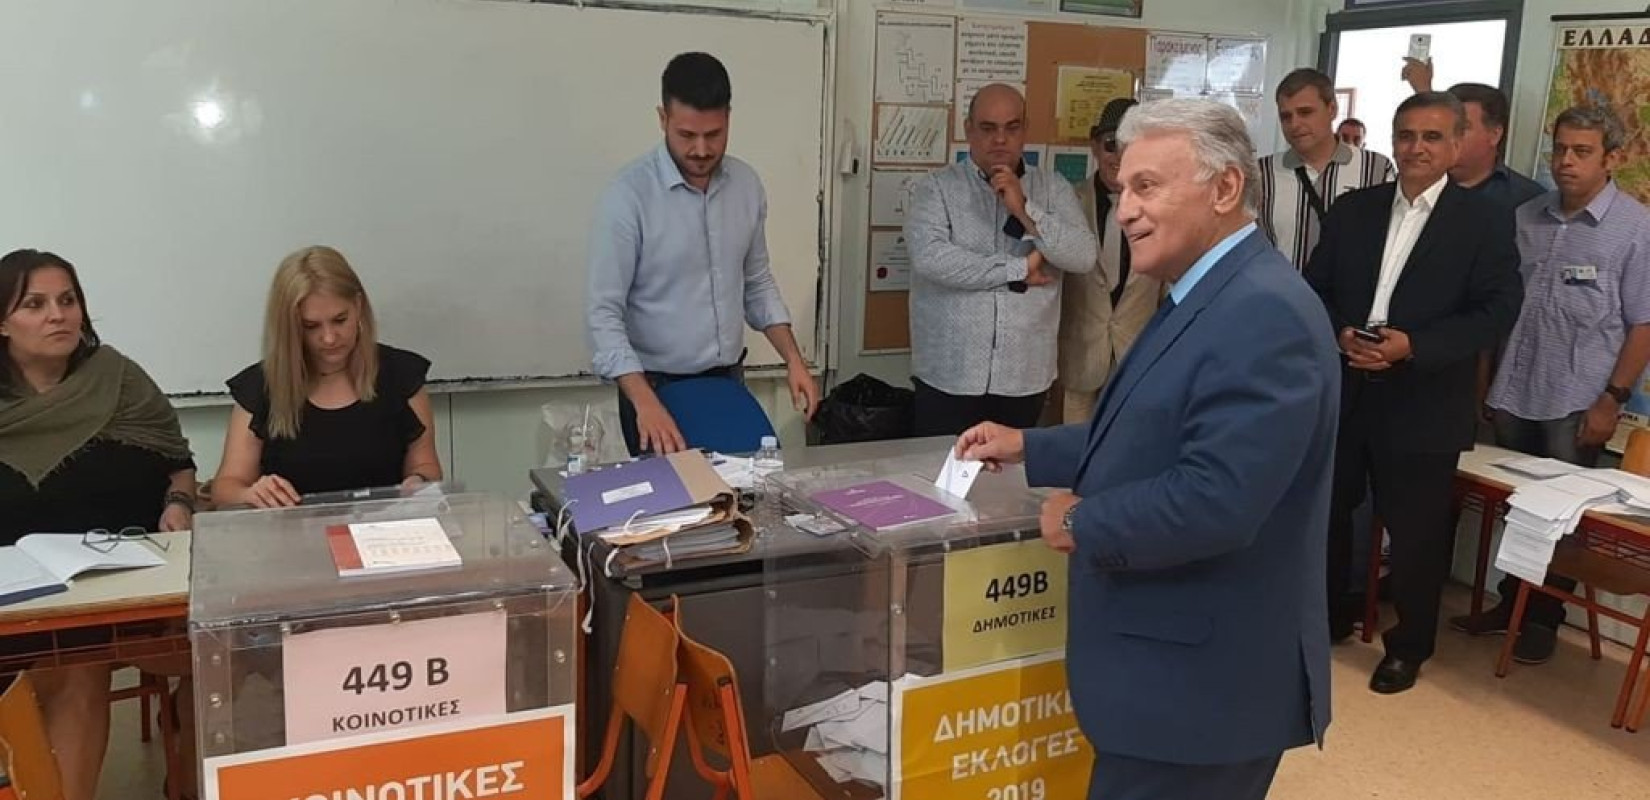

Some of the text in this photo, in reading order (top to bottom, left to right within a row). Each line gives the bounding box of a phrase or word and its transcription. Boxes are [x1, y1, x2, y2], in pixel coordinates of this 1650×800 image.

[985, 570, 1048, 603] 449Β
[973, 606, 1056, 633] ΔΗΜΟΤΙΚΕΣ
[342, 657, 449, 695] 449 Β
[332, 699, 460, 733] ΚΟΙΝΟΤΙΚΕΣ
[952, 727, 1079, 781] ΕΚΛΟΓΕΣ
